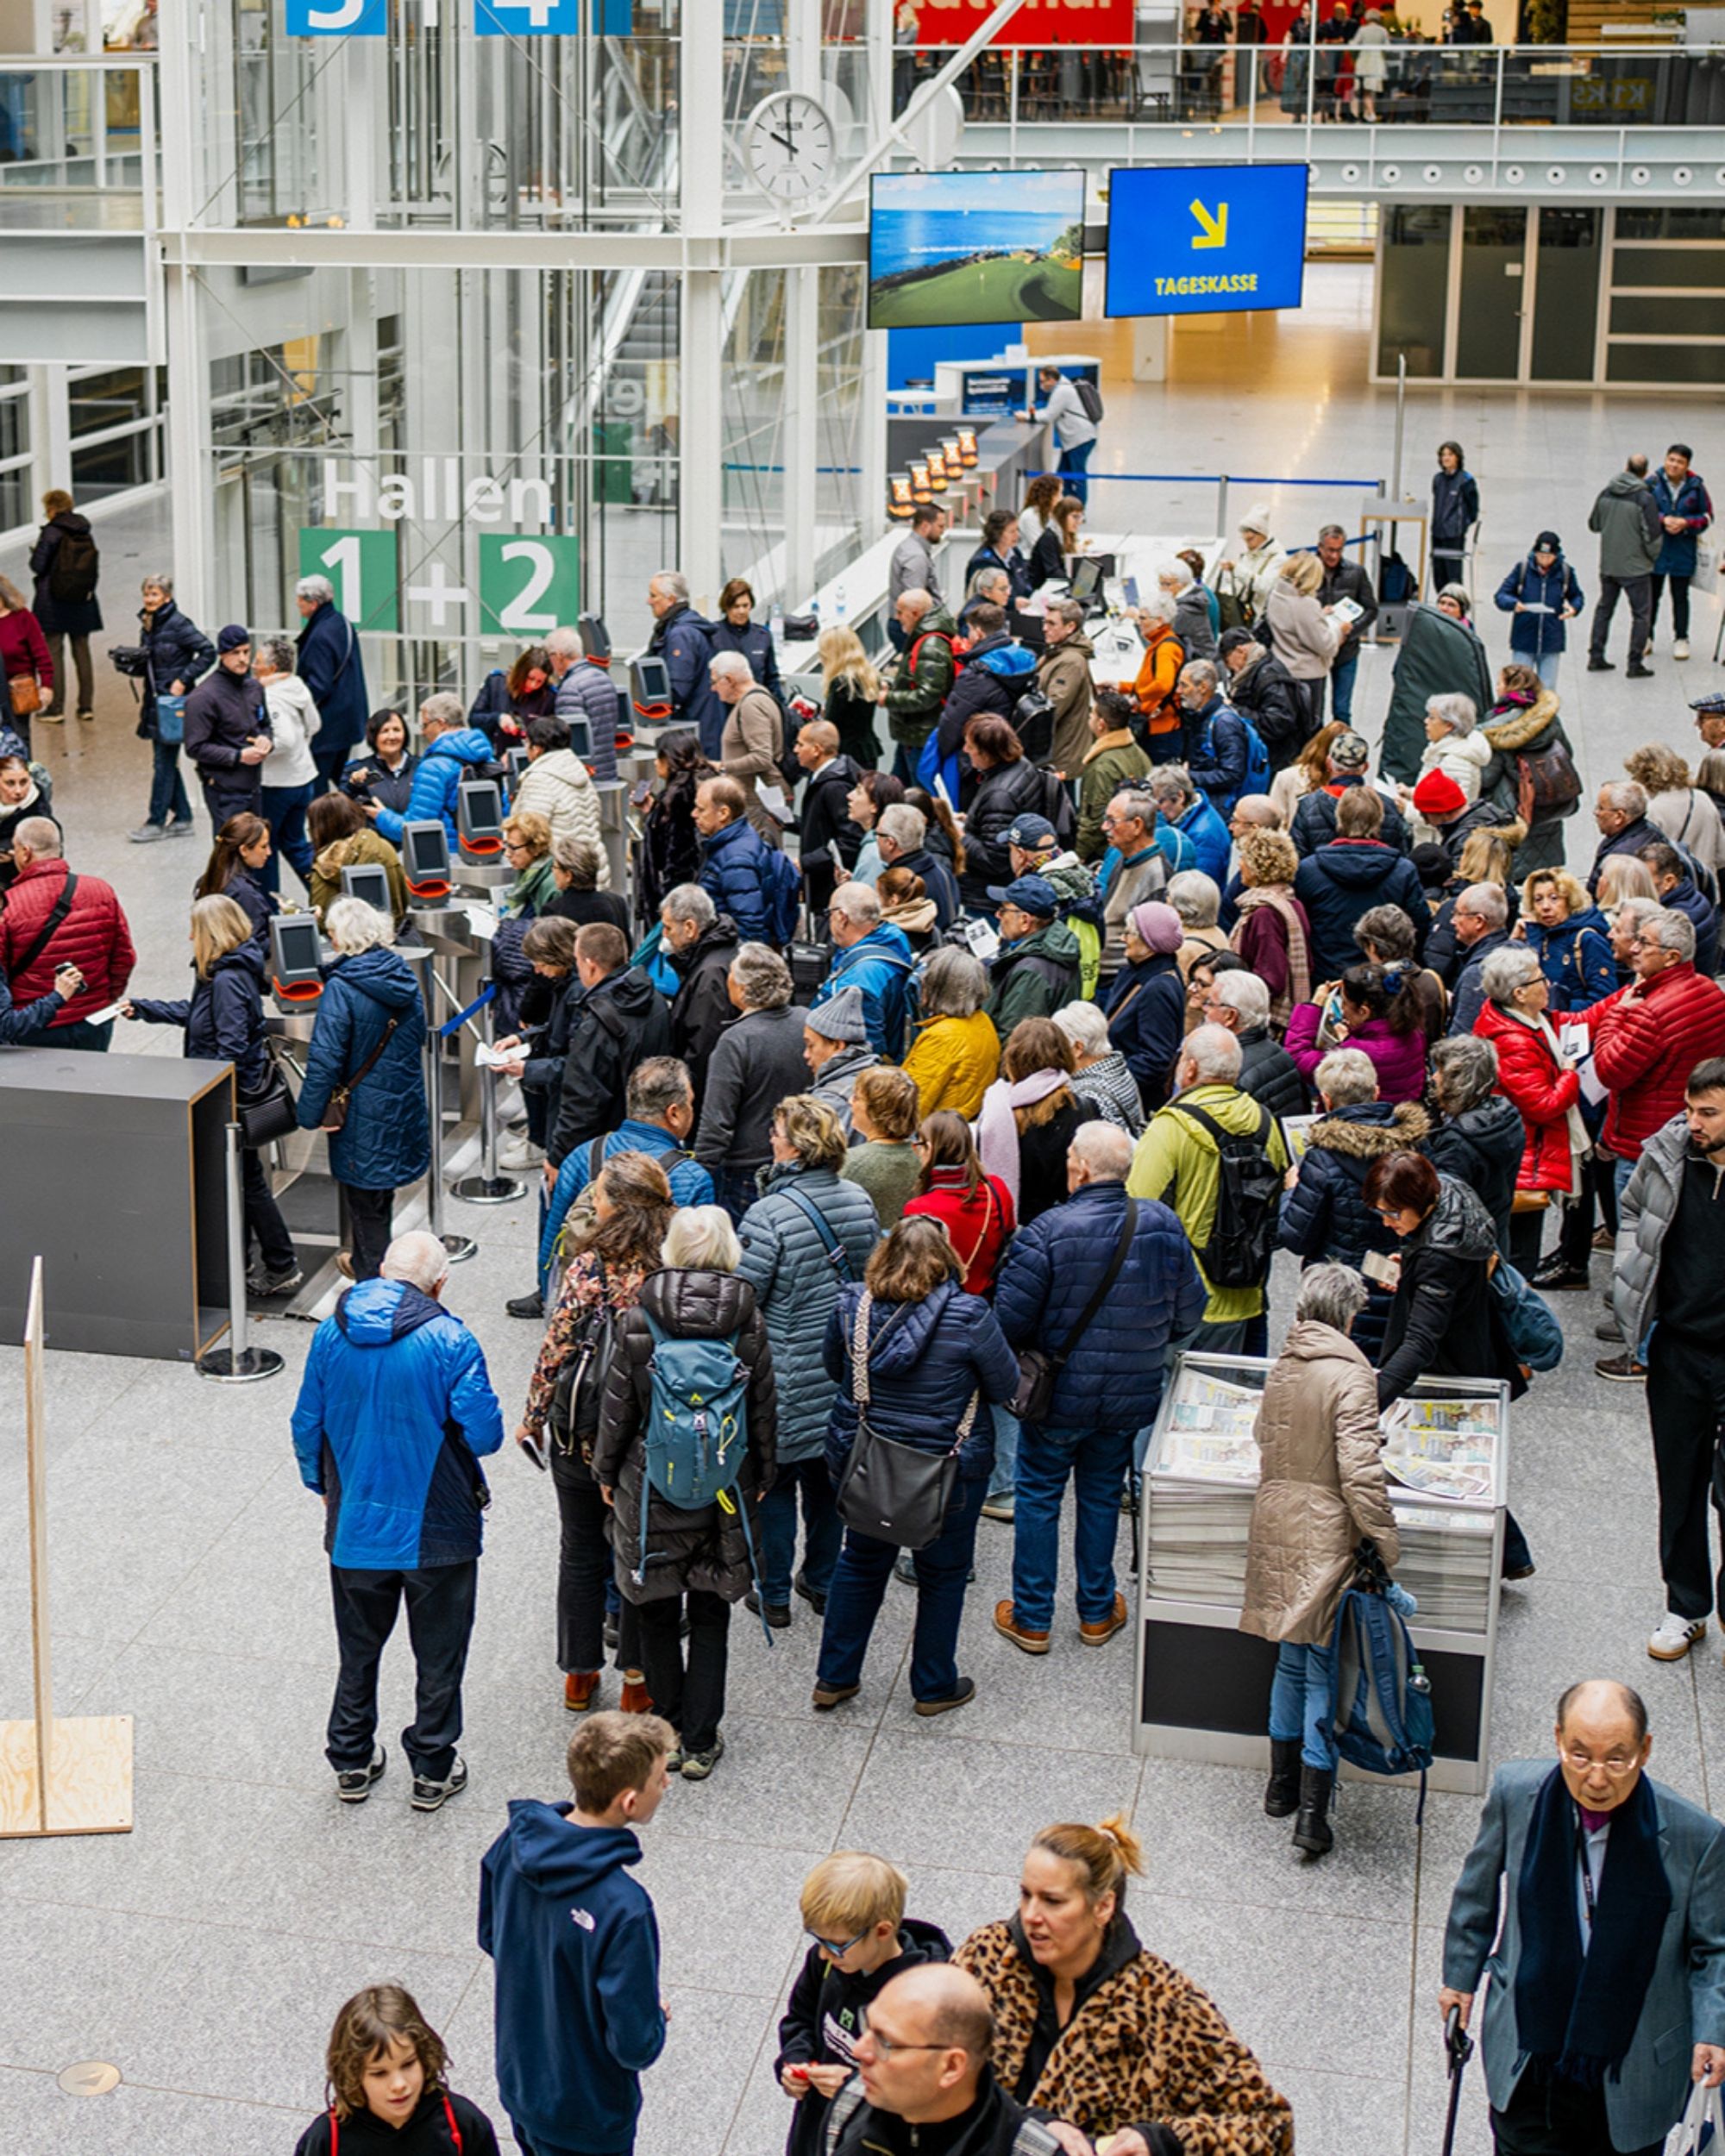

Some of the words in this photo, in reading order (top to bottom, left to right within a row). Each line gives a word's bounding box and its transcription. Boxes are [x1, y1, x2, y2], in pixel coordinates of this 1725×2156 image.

[1154, 273, 1258, 296] TAGESKASSE
[324, 456, 550, 523] Hallen
[320, 536, 361, 623] 1
[407, 562, 470, 625] +
[500, 541, 557, 630] 2
